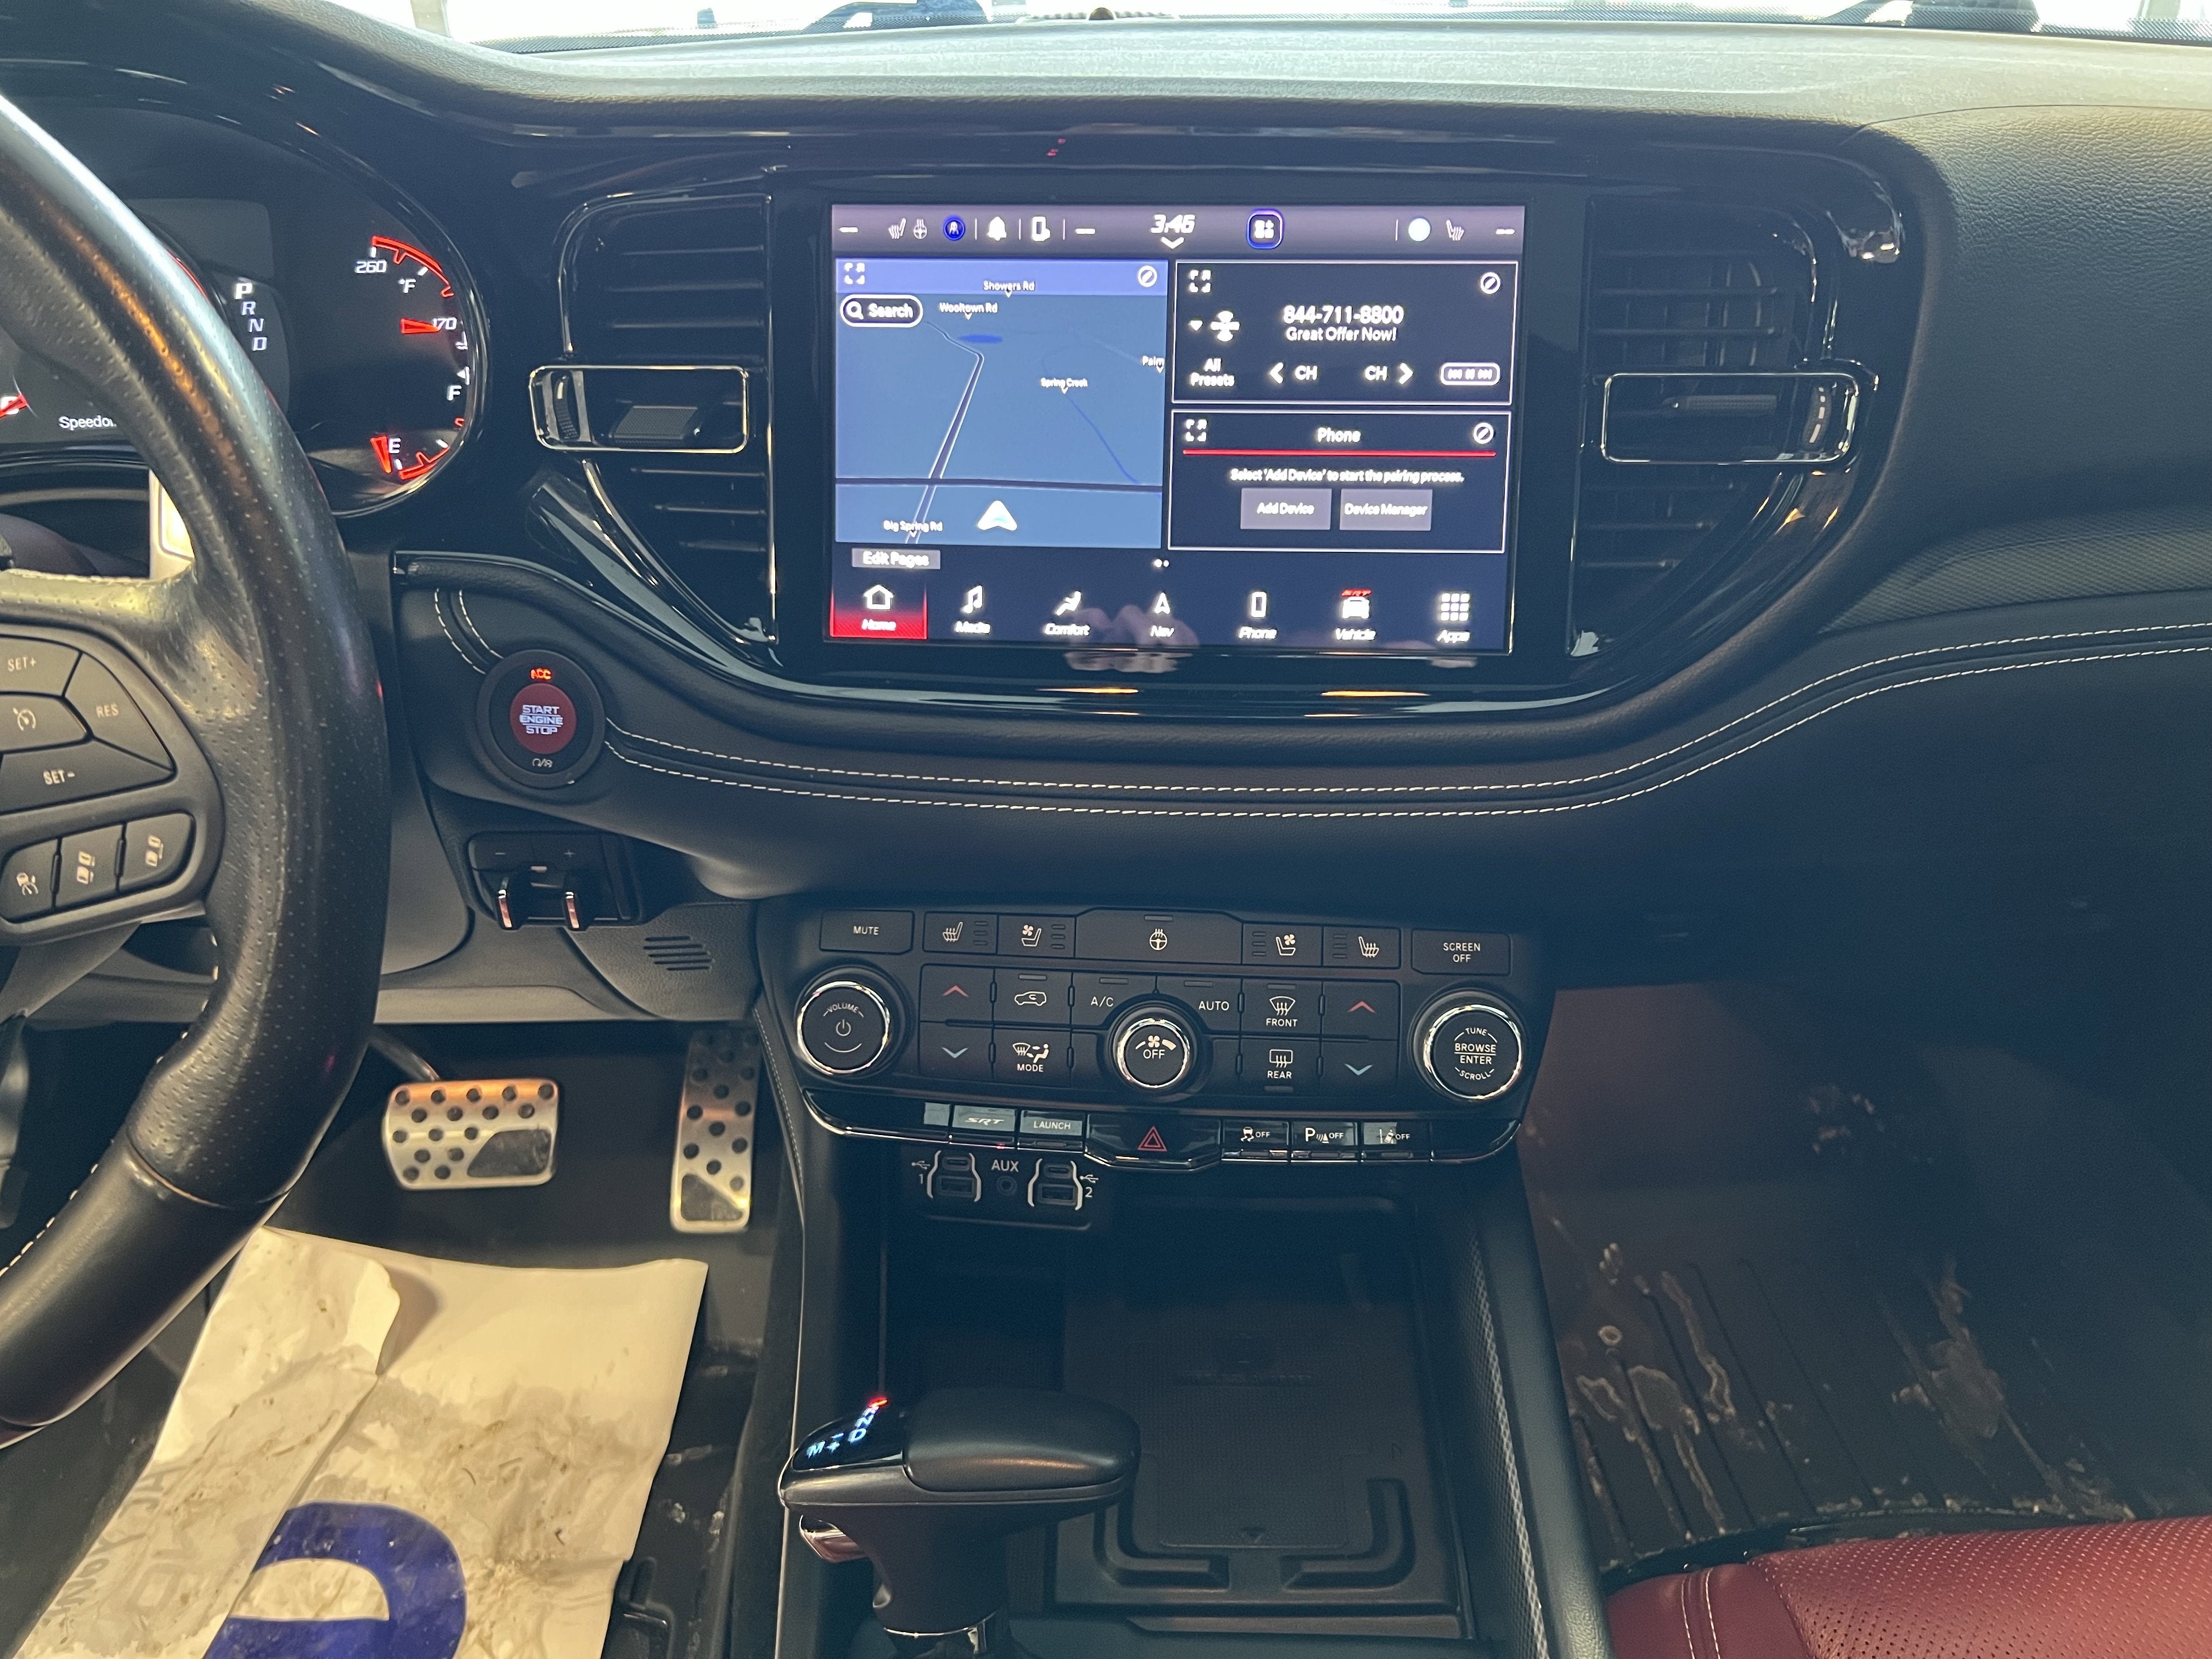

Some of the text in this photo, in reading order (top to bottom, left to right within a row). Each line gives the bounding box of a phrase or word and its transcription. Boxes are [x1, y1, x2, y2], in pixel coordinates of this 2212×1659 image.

[1150, 214, 1195, 234] 3:46
[354, 259, 387, 274] 260
[234, 281, 253, 300] P
[983, 280, 1035, 291] Showers Rd
[241, 301, 256, 315] R
[868, 303, 913, 318] Search
[985, 302, 998, 313] Rd
[1282, 305, 1404, 324] 844-711-8800
[249, 318, 264, 333] N
[1285, 326, 1397, 342] Great Offer Now!
[252, 336, 268, 351] D
[1204, 358, 1222, 373] All
[1190, 372, 1235, 387] Presets
[1294, 365, 1318, 381] CH
[1364, 365, 1388, 381] CH
[447, 385, 462, 401] F
[1316, 427, 1361, 443] Phone
[389, 438, 402, 454] E
[1231, 468, 1262, 481] Select
[1327, 471, 1338, 482] to
[1340, 470, 1364, 482] start
[1365, 469, 1383, 482] the
[1384, 470, 1420, 483] pairing
[1256, 502, 1314, 515] Add Device
[1344, 503, 1428, 517] Device Manager
[863, 551, 930, 568] Edit Pages
[862, 619, 897, 632] Home
[956, 621, 991, 634] Media
[1045, 623, 1090, 636] Comfort
[1152, 625, 1175, 638] Nav
[1239, 627, 1277, 640] Phone
[1335, 627, 1376, 641] Vehicle
[1436, 629, 1470, 644] Apps
[531, 668, 551, 680] ACC
[96, 704, 119, 718] RES
[522, 705, 560, 714] START
[520, 715, 563, 725] ENGINE
[853, 926, 879, 935] MUTE
[1443, 943, 1481, 951] SCREEN
[1453, 954, 1471, 962] OFF
[827, 1003, 859, 1013] VOLUME
[1091, 996, 1114, 1007] A/C
[1198, 1001, 1229, 1011] AUTO
[1266, 1018, 1297, 1027] FRONT
[1465, 1027, 1487, 1036] TUNE
[1143, 1048, 1165, 1059] OFF
[1454, 1043, 1497, 1053] BROWSE
[1460, 1055, 1492, 1064] ENTER
[1017, 1063, 1043, 1073] MODE
[1267, 1070, 1292, 1079] REAR
[1459, 1070, 1491, 1080] SCROLL
[966, 1118, 1005, 1126] SRT
[1034, 1120, 1071, 1130] LAUNCH
[991, 1159, 1019, 1172] AUX
[919, 1173, 923, 1184] 1
[1085, 1186, 1092, 1198] 2
